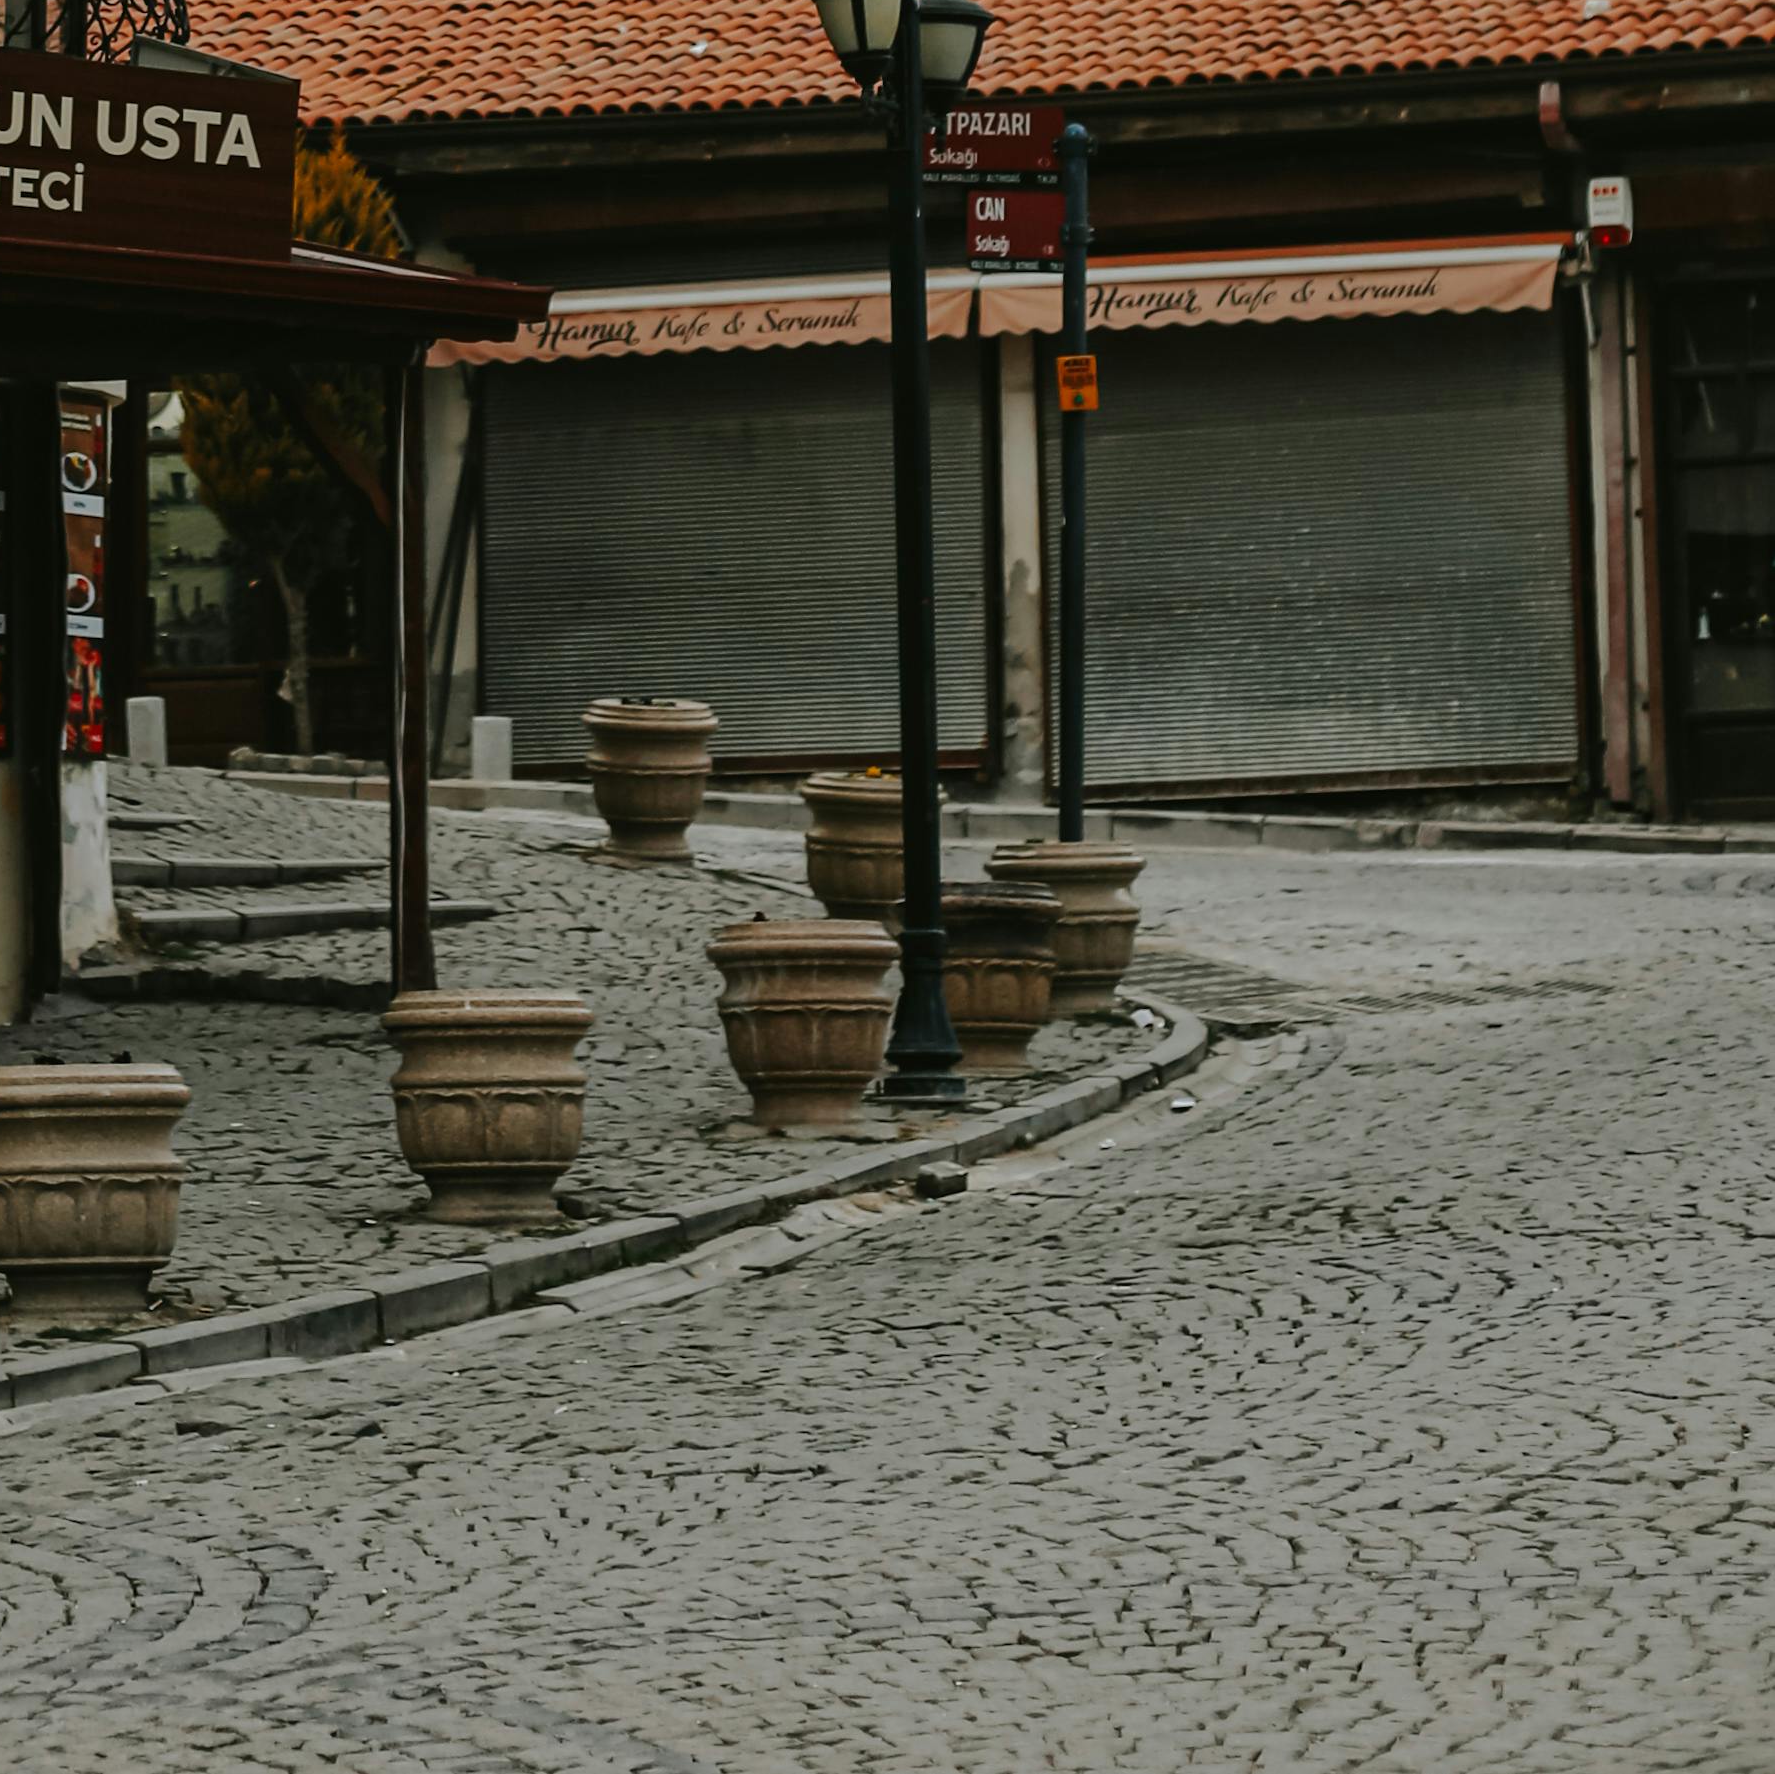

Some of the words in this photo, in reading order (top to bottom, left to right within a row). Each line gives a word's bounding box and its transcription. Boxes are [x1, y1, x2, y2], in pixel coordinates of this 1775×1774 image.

[95, 101, 262, 169] USTA
[930, 111, 1031, 138] TPAZARI
[975, 197, 1005, 222] CAN
[1088, 284, 1202, 319] Hamur
[1216, 282, 1279, 308] Kafe
[1290, 280, 1314, 303] &
[1326, 269, 1443, 302] Seramik
[526, 316, 642, 353] Hamur
[651, 312, 712, 341] Kafe
[723, 311, 746, 335] &
[756, 299, 863, 335] Seramik
